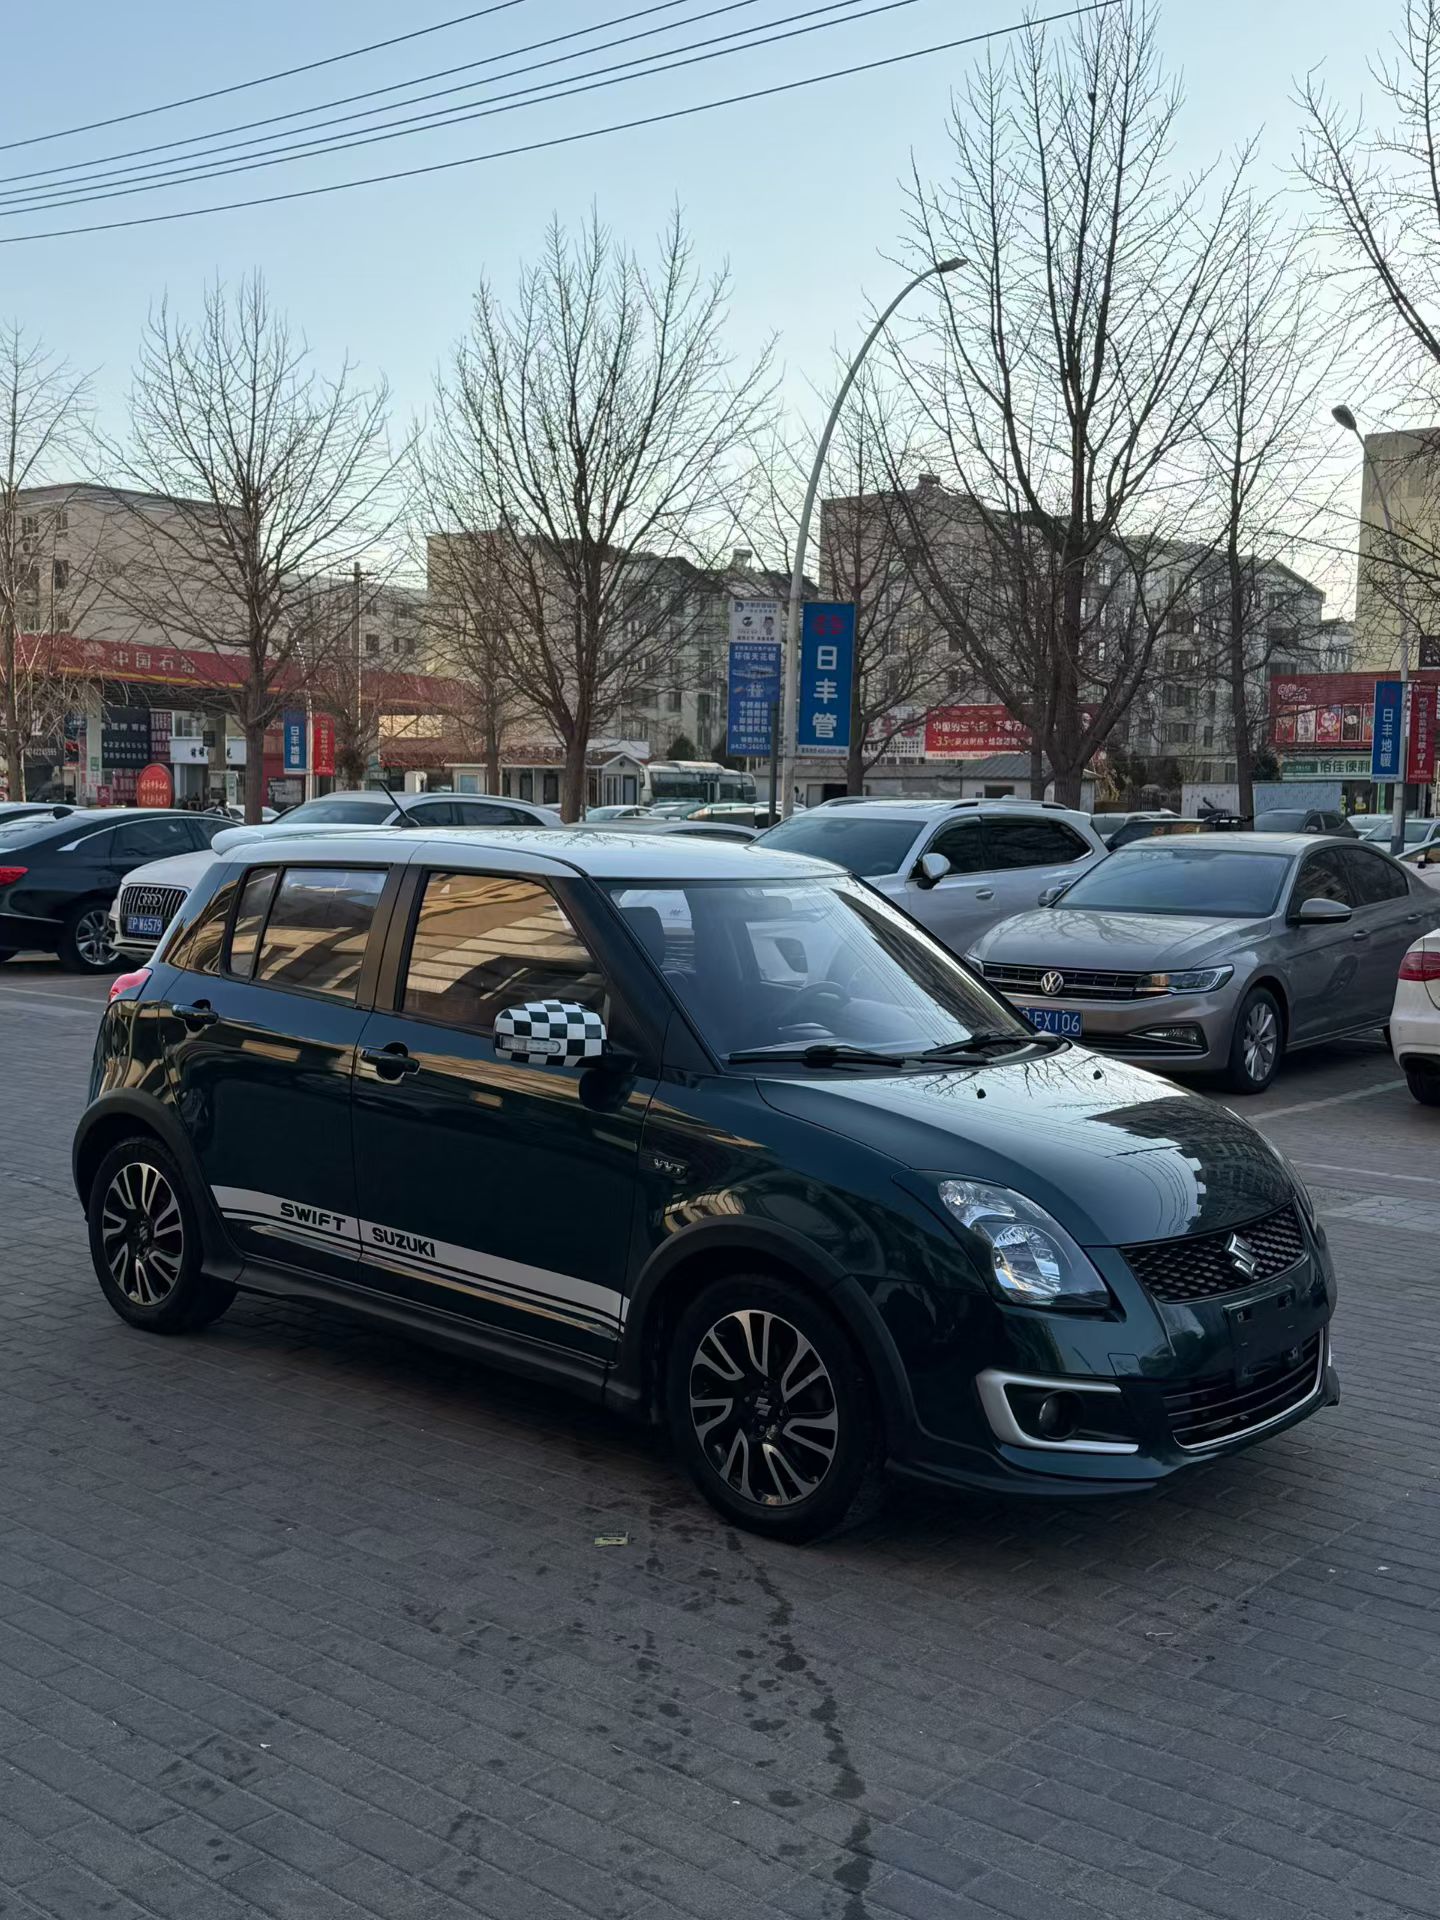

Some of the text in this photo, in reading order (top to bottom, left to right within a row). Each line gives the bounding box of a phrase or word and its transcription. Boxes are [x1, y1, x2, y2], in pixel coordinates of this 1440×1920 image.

[112, 650, 195, 674] 中国石油
[812, 645, 838, 738] 日丰管
[1380, 708, 1393, 767] 日丰地暖
[1320, 760, 1370, 773] 佰佳便利
[280, 1202, 346, 1231] SWIFT
[372, 1227, 436, 1258] SUZUKI
